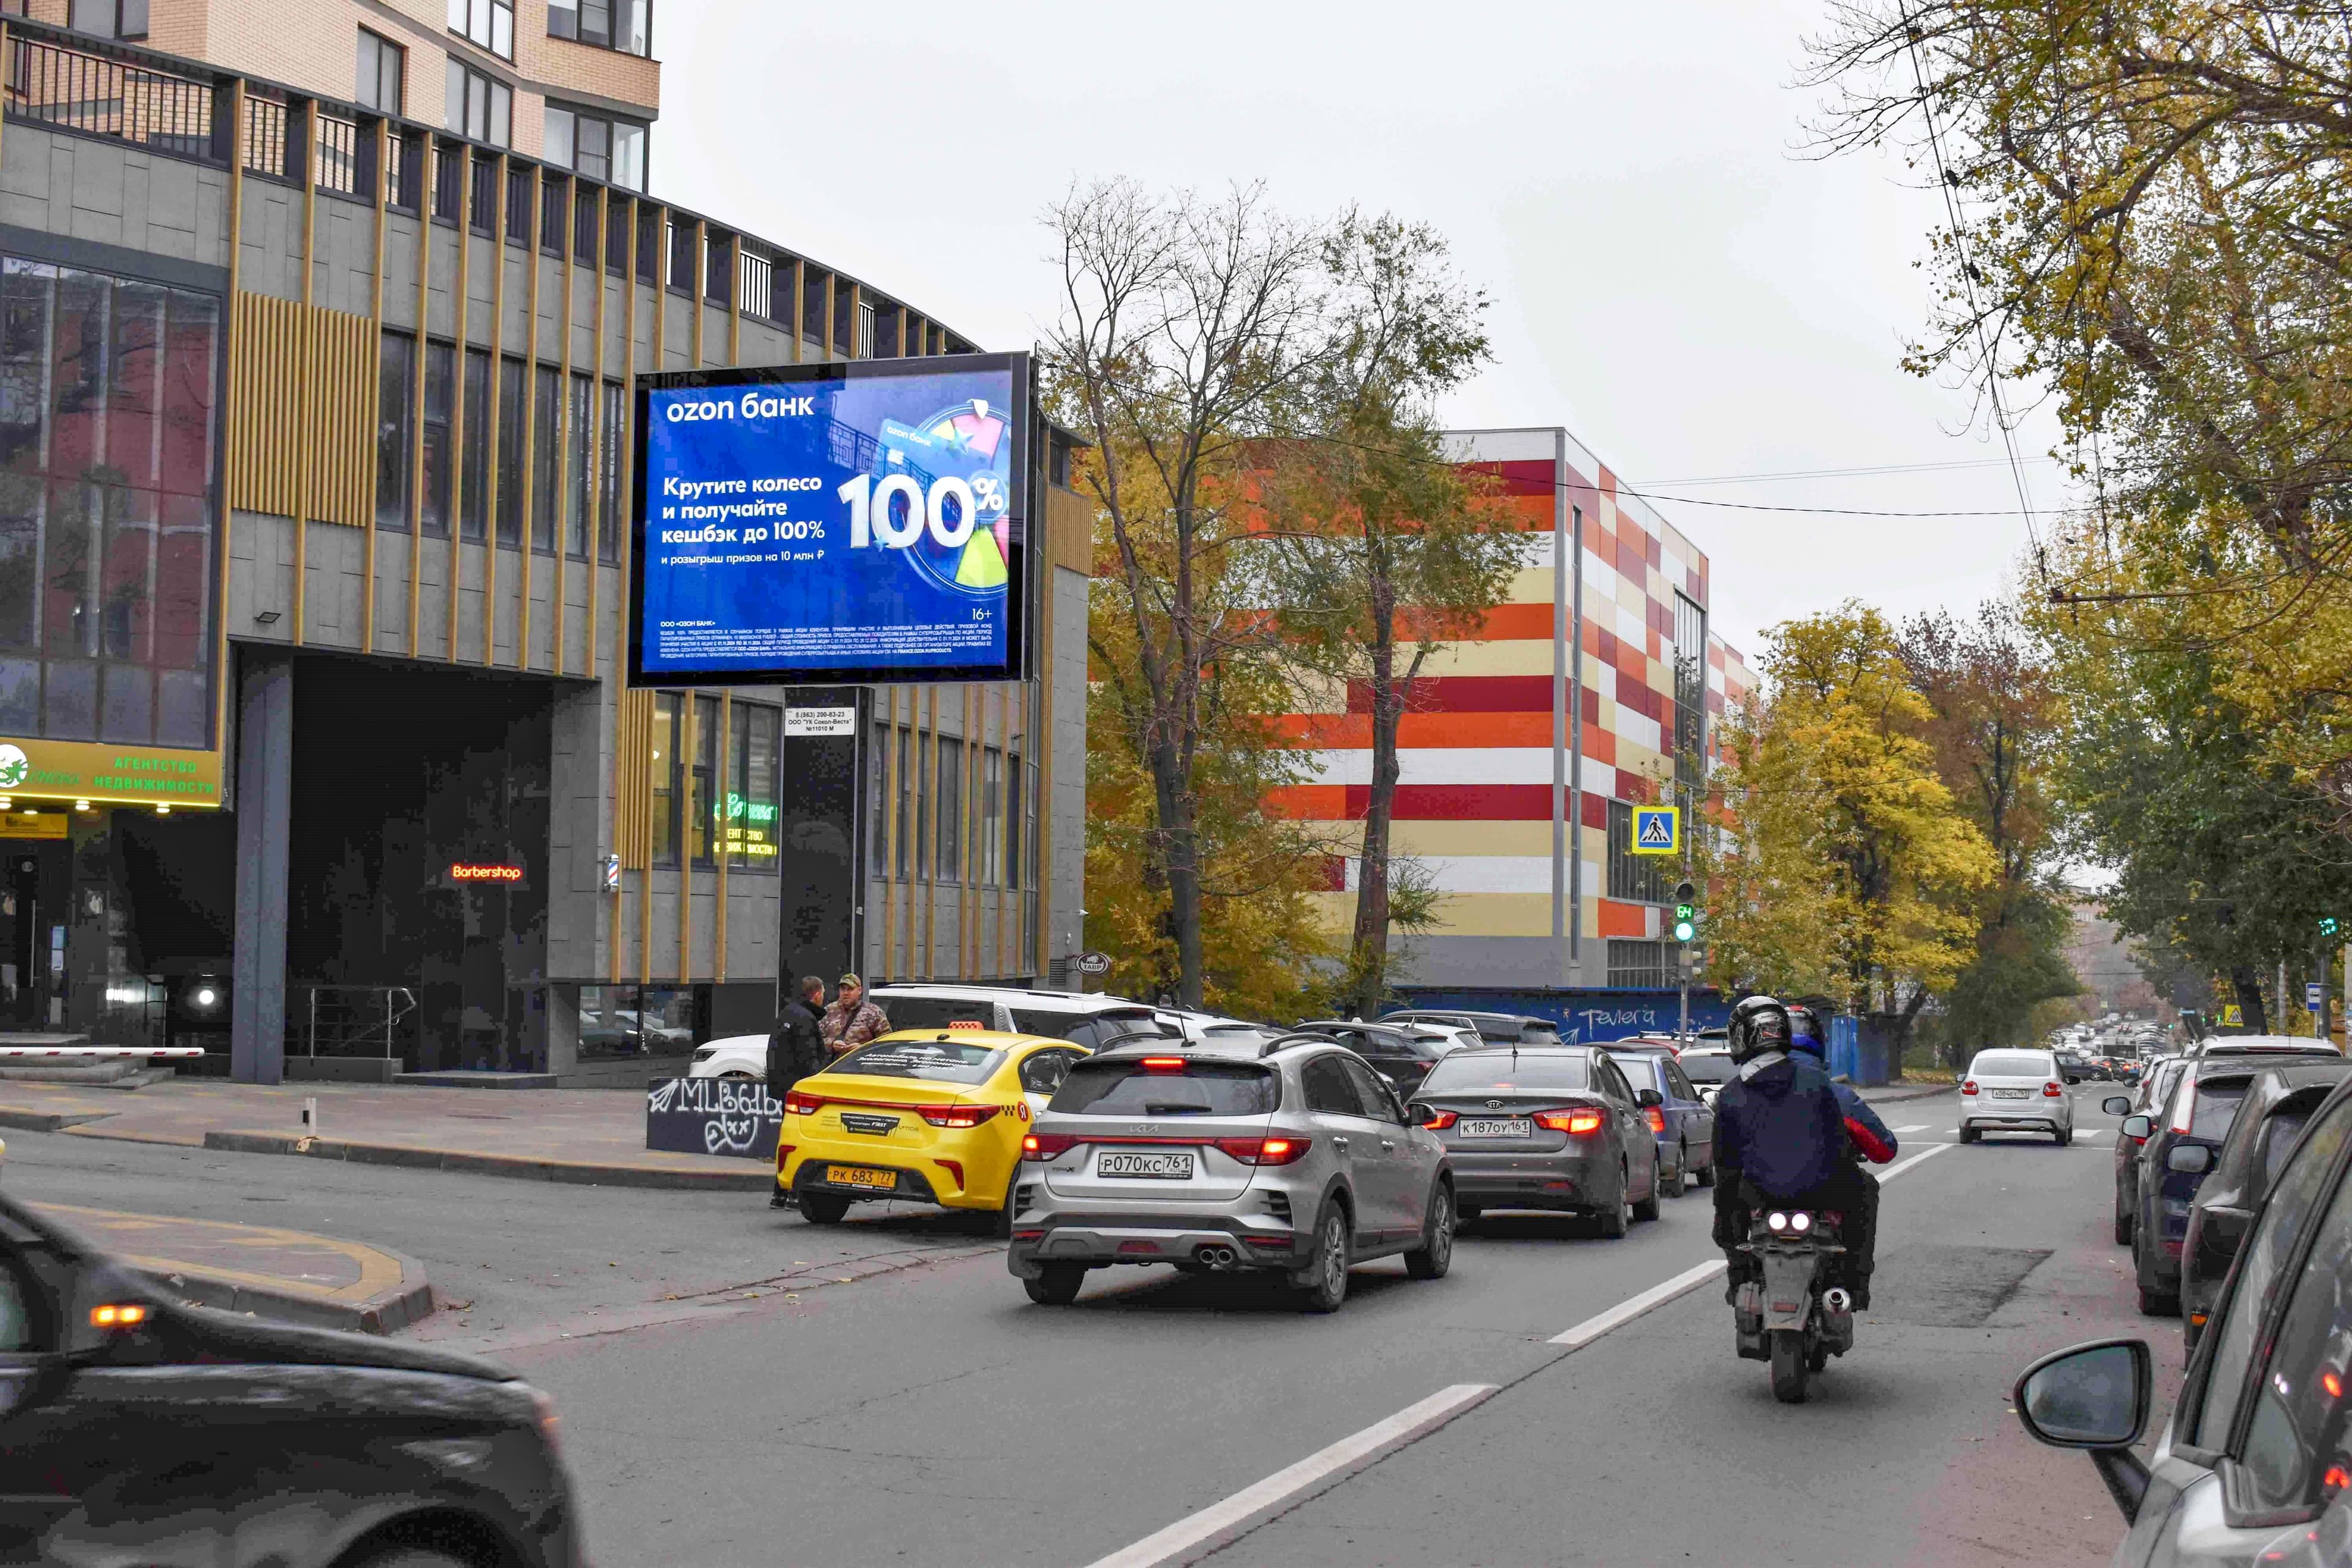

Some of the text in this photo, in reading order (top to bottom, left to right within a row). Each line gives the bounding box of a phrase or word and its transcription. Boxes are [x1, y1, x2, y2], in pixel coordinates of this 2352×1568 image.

[667, 393, 815, 422] ozon банк
[663, 477, 822, 500] Крутите колесо
[662, 499, 788, 522] и получайте
[837, 473, 1003, 549] 100%
[662, 521, 825, 544] кешбэк до 100%
[671, 554, 723, 566] розыгрыш
[726, 553, 762, 565] призов
[765, 552, 778, 562] на
[781, 551, 791, 561] 10
[793, 551, 814, 560] млн
[972, 608, 993, 620] 16+
[114, 756, 197, 773] АГЕНТСТВО
[94, 775, 214, 794] НЕДВИЖИМОСТИ
[453, 865, 521, 880] Barbershop
[1677, 906, 1692, 918] 64
[1020, 1104, 1027, 1119] Я
[1463, 1121, 1528, 1133] К187ОУ 161
[1104, 1156, 1189, 1172] Р070КС 761
[833, 1170, 847, 1182] РК
[851, 1170, 874, 1183] 683
[880, 1171, 892, 1182] 77
